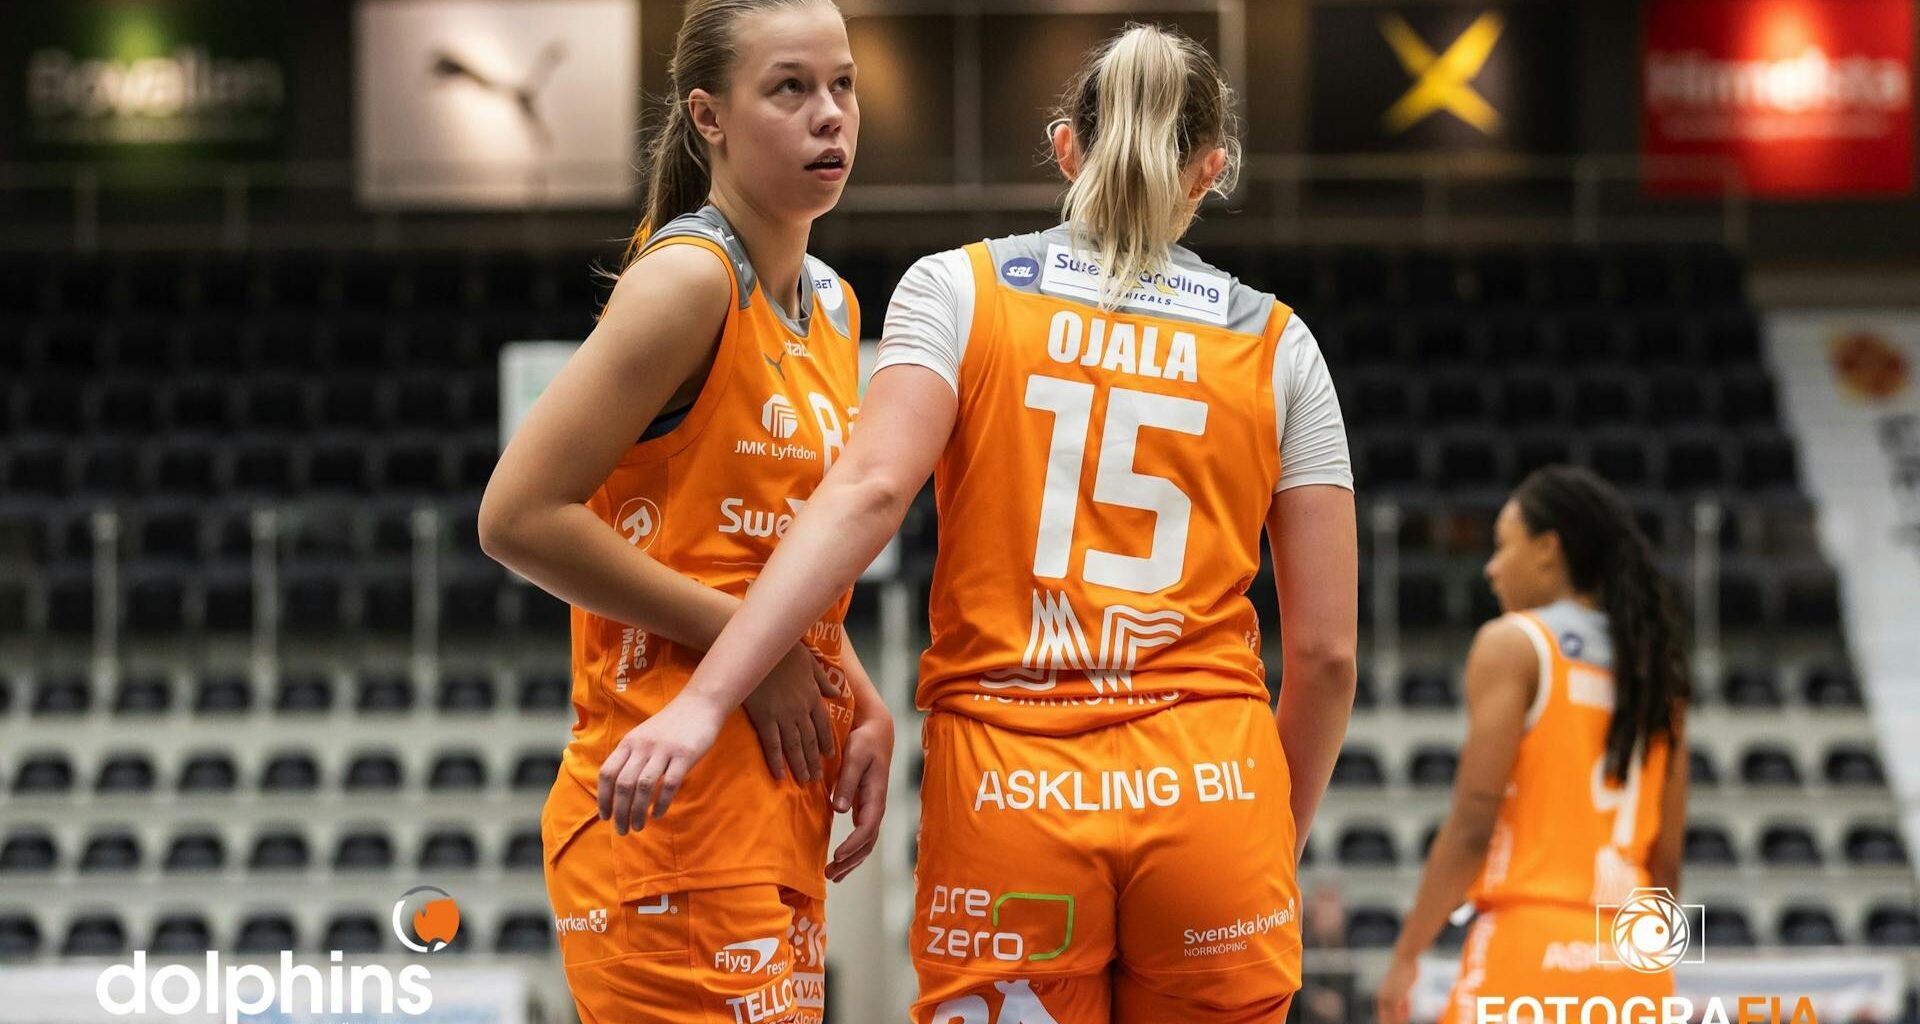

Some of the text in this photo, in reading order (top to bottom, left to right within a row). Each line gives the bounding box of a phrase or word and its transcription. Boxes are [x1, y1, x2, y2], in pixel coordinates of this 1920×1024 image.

[1007, 265, 1034, 278] SBL
[1047, 310, 1198, 384] OJALA
[734, 440, 817, 461] JMK Lyftdon
[1024, 373, 1209, 594] 15
[615, 628, 636, 692] Maskin
[974, 766, 1181, 812] ASKLING
[929, 885, 991, 921] pre
[555, 913, 589, 936] kyrkan
[1184, 909, 1290, 945] Svenska kyrkan
[926, 925, 1024, 961] zero
[1183, 940, 1249, 957] NORRKÖPING
[715, 950, 752, 974] Flyg
[725, 978, 793, 1024] TELLO
